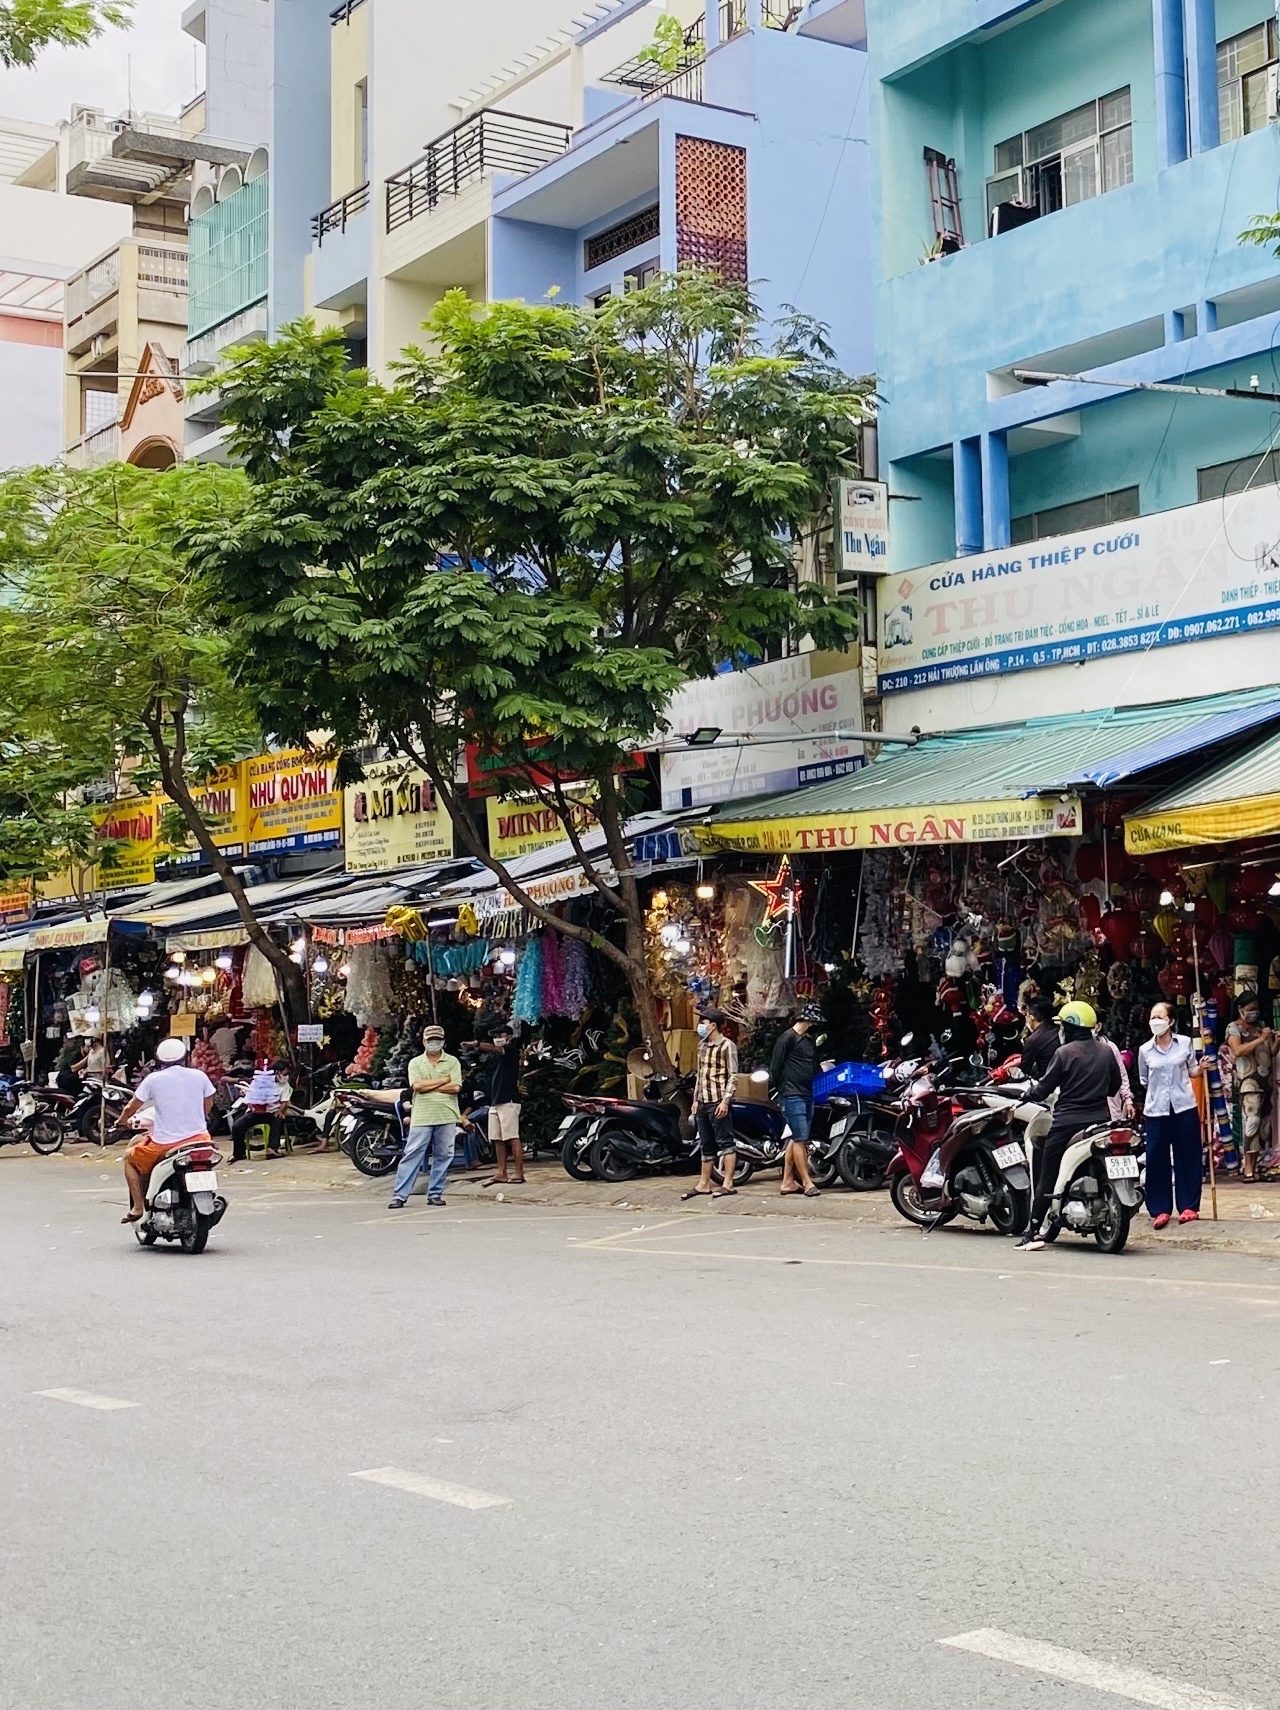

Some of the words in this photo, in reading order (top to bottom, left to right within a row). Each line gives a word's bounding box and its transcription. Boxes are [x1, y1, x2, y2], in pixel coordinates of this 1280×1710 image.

[844, 531, 862, 553] Thu
[864, 533, 887, 561] Ngân
[929, 570, 965, 591] CỬA
[971, 560, 1022, 582] HÀNG
[1028, 546, 1087, 570] THIỆP
[1093, 532, 1140, 556] CƯỚI
[924, 583, 1038, 637] THU
[1060, 543, 1230, 611] NGÂN
[1221, 588, 1239, 605] DANH
[1076, 620, 1089, 632] HOA
[1094, 613, 1110, 627] NOEL
[895, 675, 908, 689] 210
[914, 672, 927, 686] 212
[1008, 653, 1024, 668] P.14
[1184, 615, 1241, 637] 0907.062.271
[250, 774, 277, 808] NHƯ
[281, 767, 328, 802] QUỲNH
[796, 826, 858, 850] THU
[869, 813, 967, 845] NGÂN
